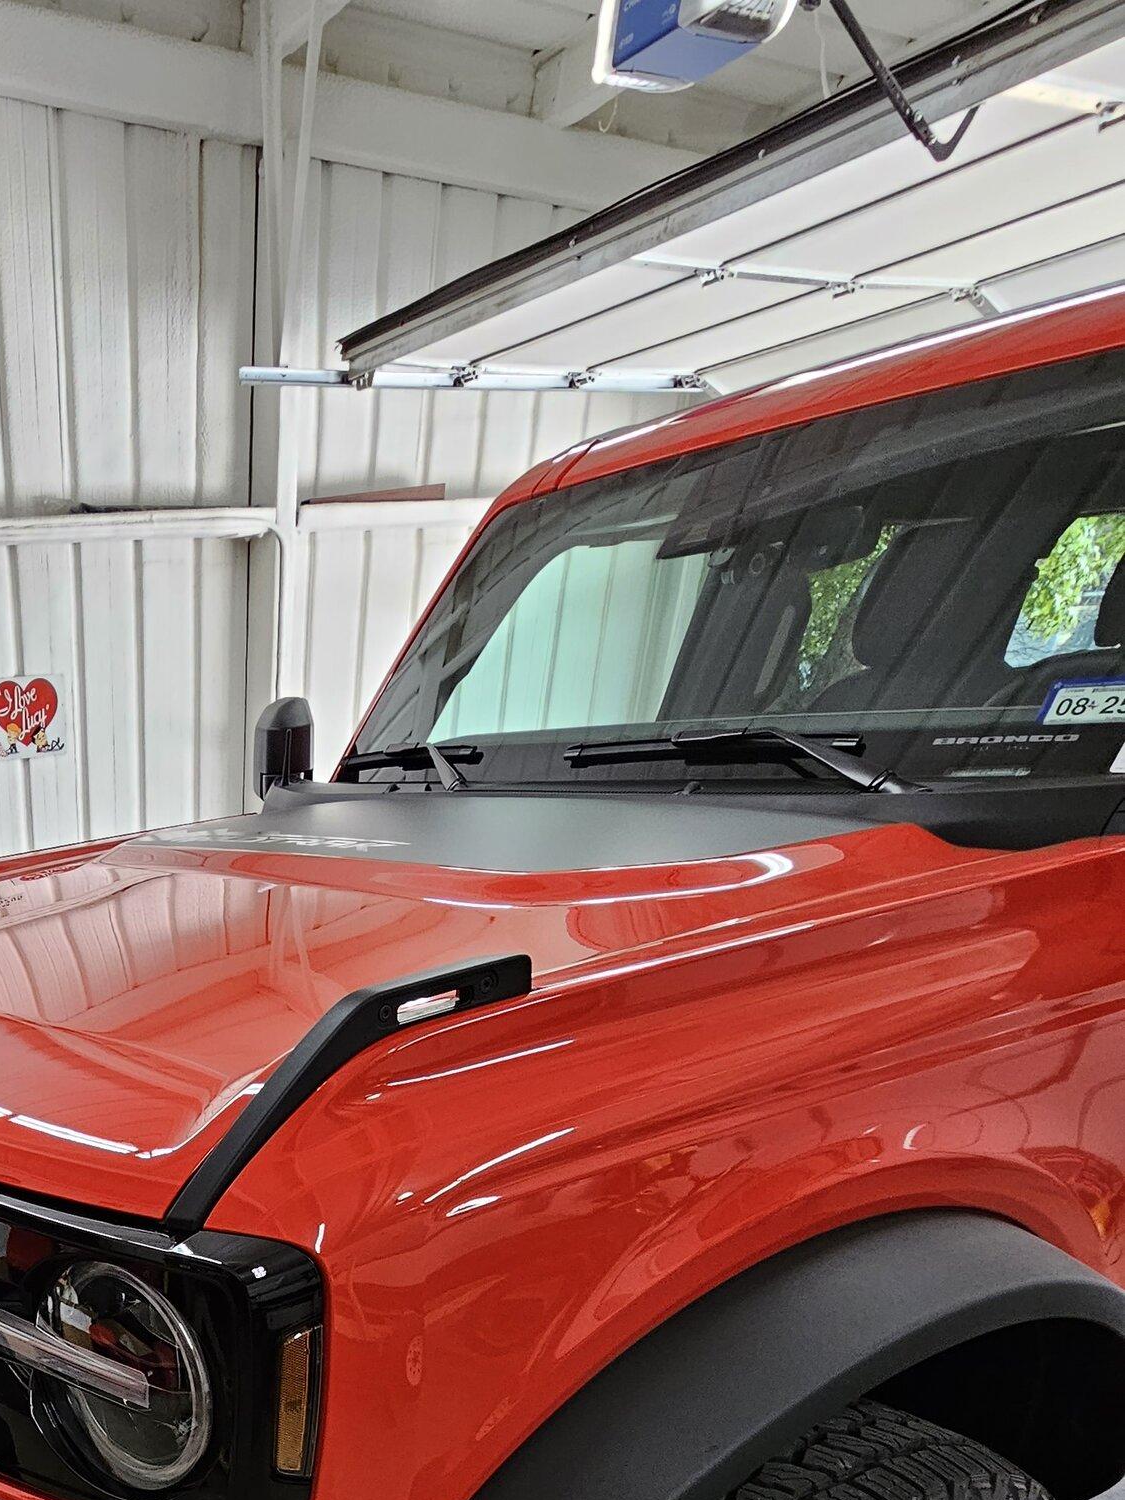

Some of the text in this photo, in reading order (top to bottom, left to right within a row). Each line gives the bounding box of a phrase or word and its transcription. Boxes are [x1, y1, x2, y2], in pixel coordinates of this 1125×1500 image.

[10, 685, 37, 720] Love
[1056, 698, 1090, 716] 08
[932, 734, 1080, 745] BRONCO
